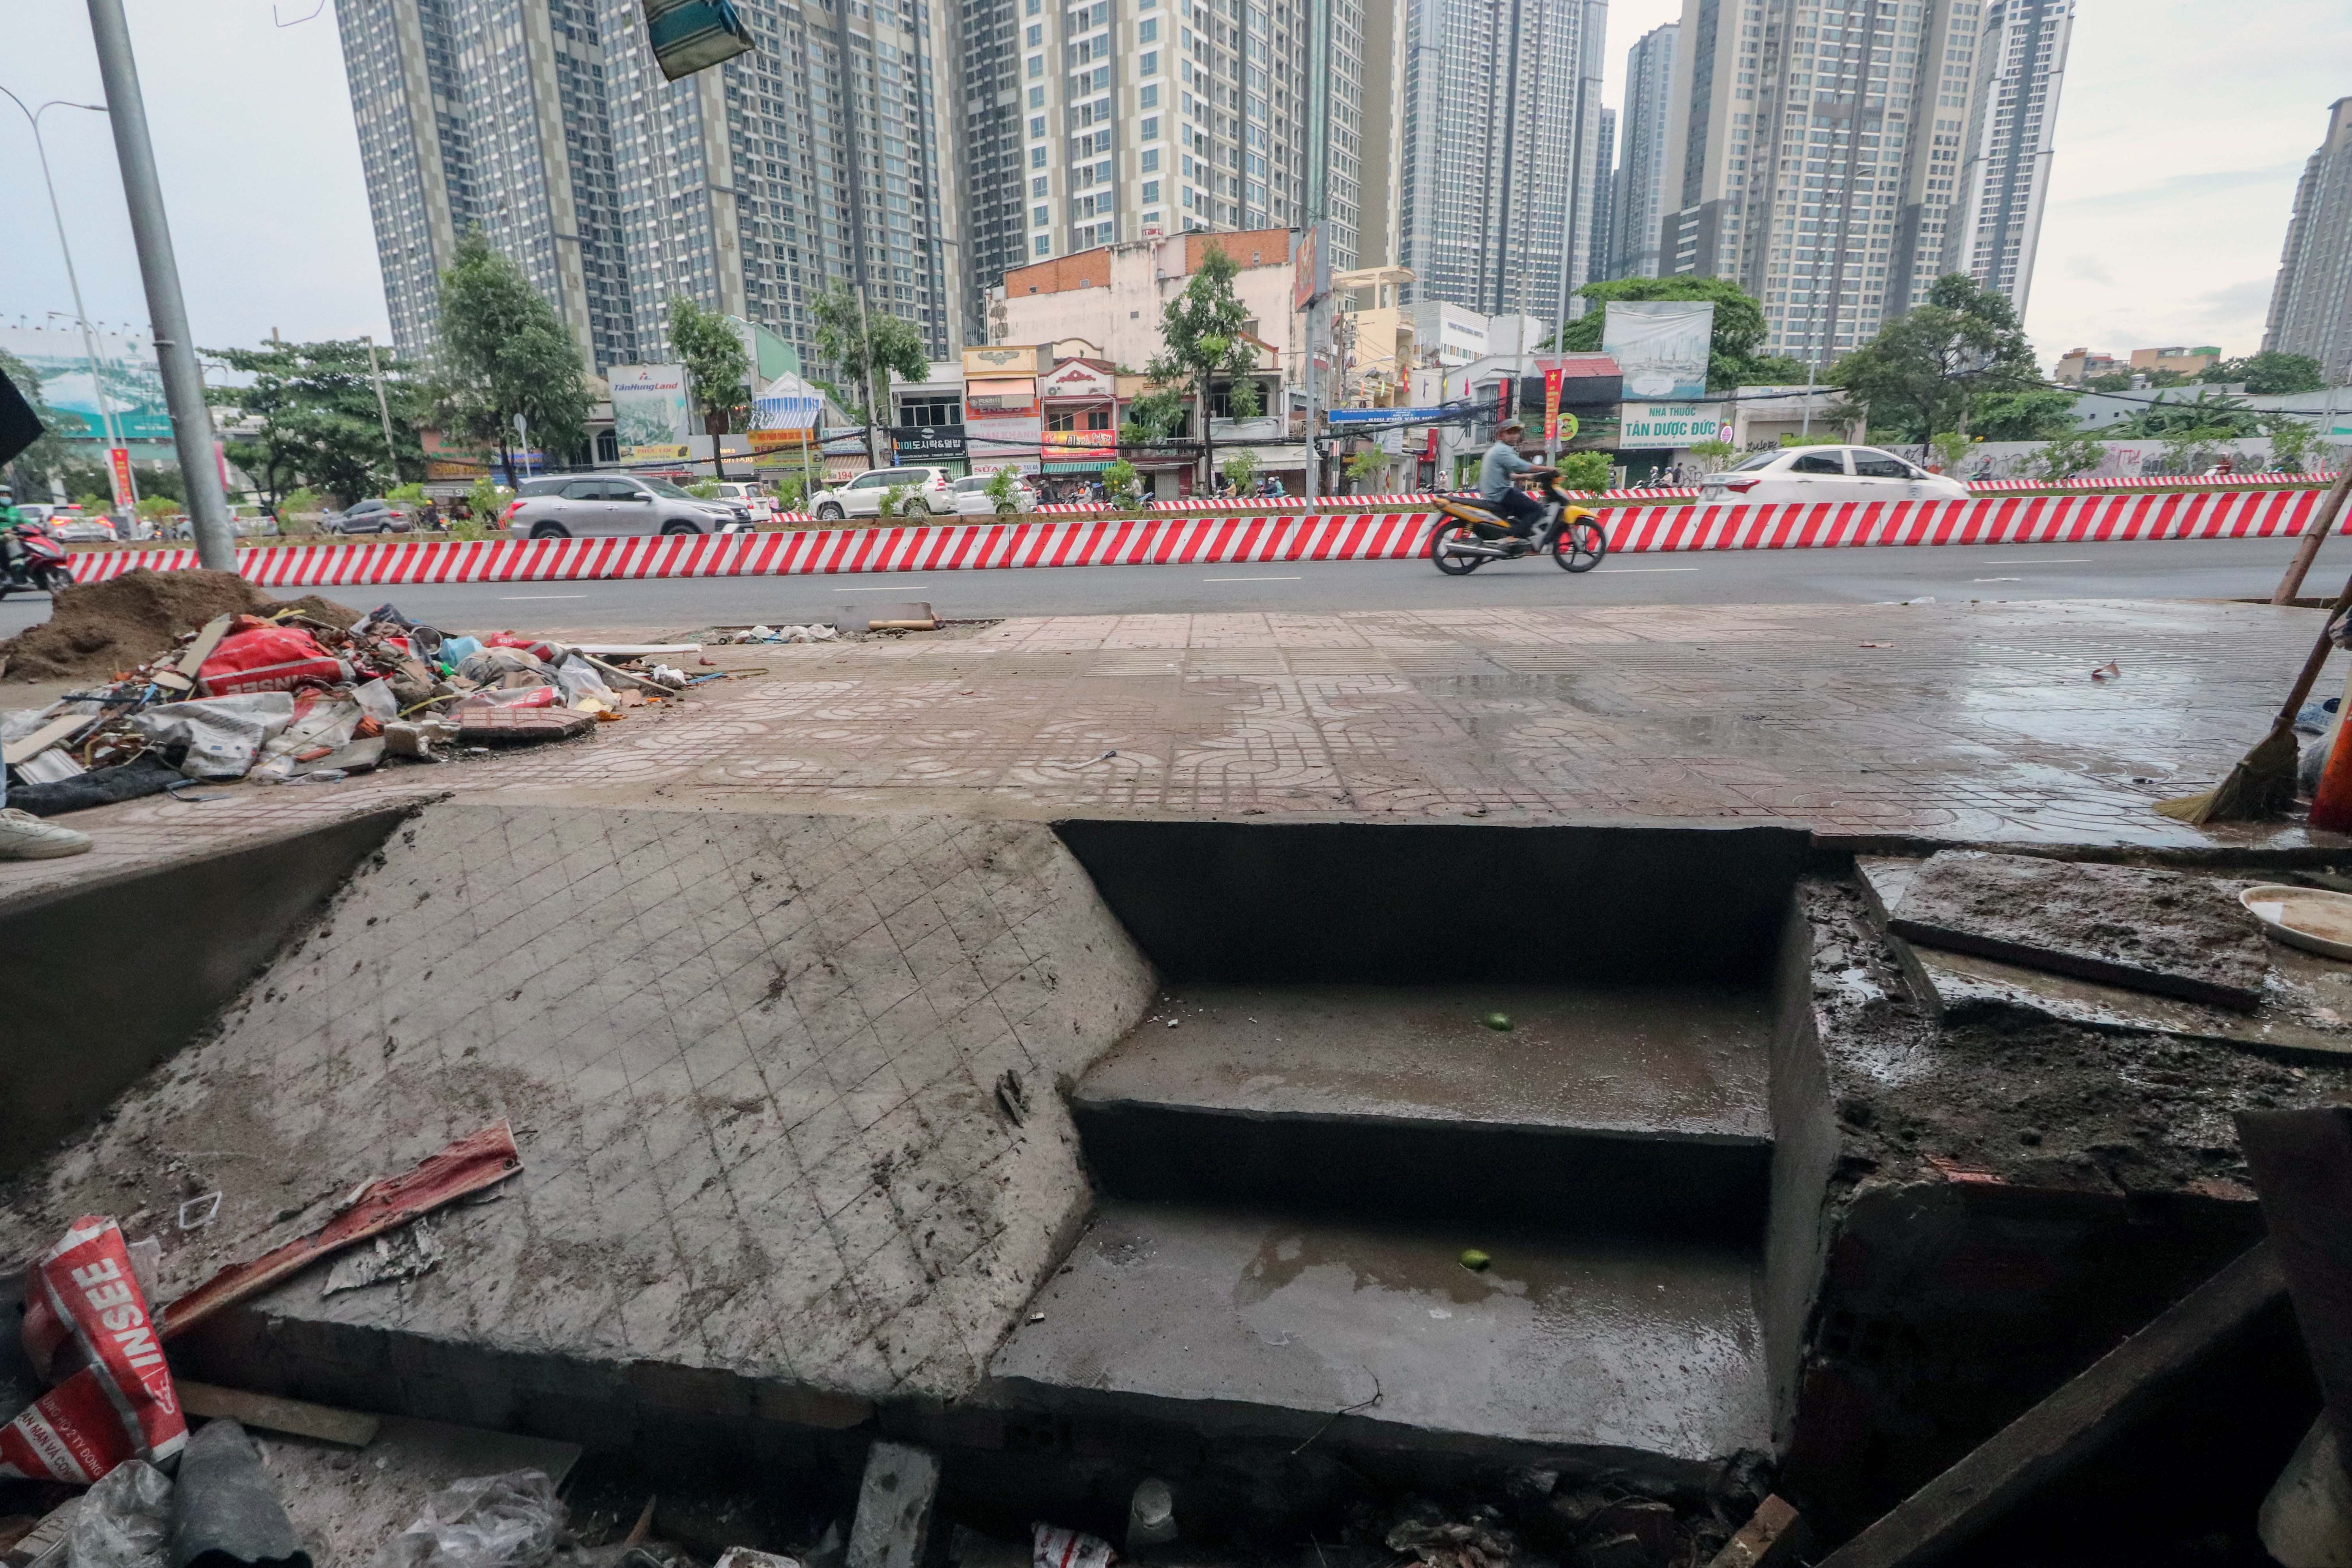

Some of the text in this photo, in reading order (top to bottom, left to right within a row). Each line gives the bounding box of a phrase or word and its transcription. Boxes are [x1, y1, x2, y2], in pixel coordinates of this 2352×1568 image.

[1625, 419, 1716, 438] TÂN DƯỢC ĐỨC
[838, 471, 853, 480] 194
[71, 1257, 163, 1369] INSEE
[66, 1429, 77, 1438] 2
